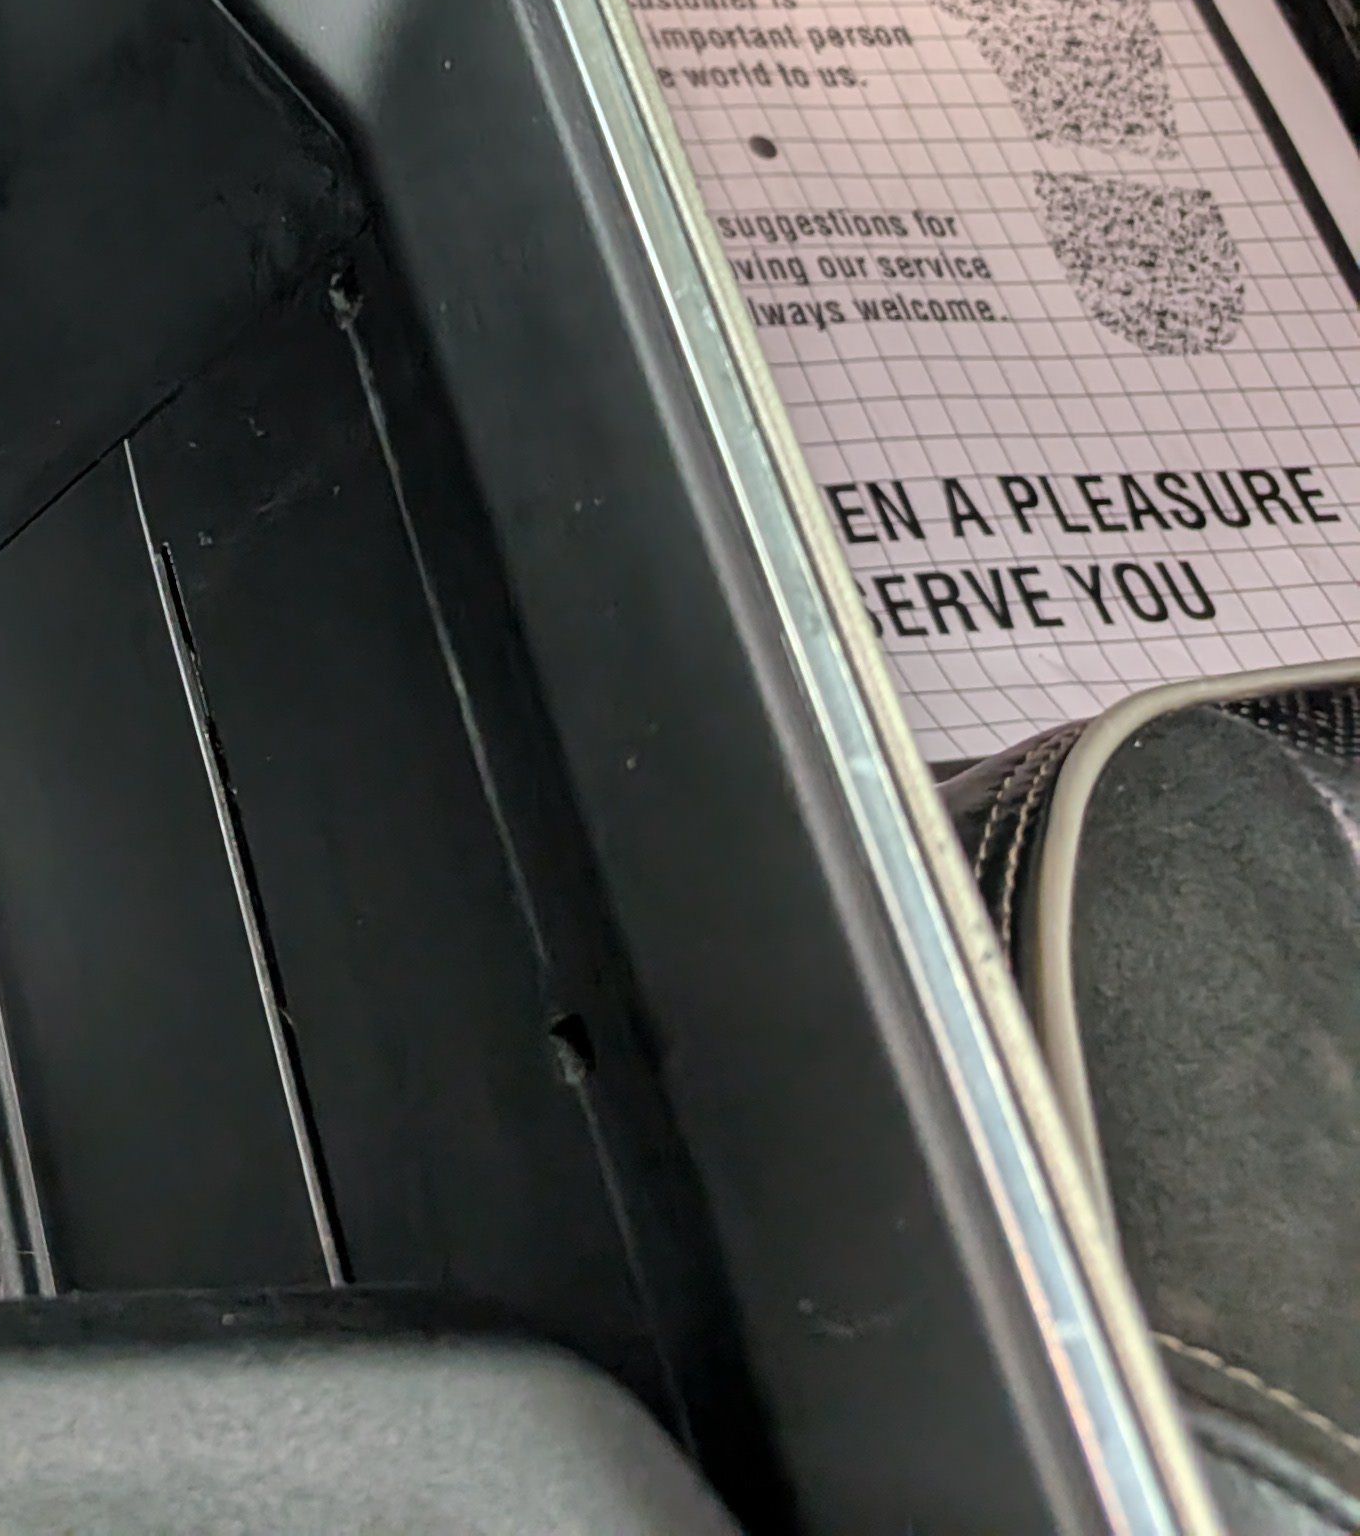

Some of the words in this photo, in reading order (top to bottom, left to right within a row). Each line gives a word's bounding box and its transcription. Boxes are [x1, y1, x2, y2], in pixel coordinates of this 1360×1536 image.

[646, 23, 800, 55] important
[806, 25, 914, 55] person
[682, 60, 772, 88] world
[776, 62, 811, 88] to
[816, 65, 868, 88] us.
[717, 209, 908, 242] suggestions
[912, 210, 958, 237] for
[817, 255, 868, 279] our
[879, 250, 992, 279] service
[853, 293, 1008, 323] welcome.
[942, 477, 994, 539] A
[1000, 467, 1341, 534] PLEASURE
[1060, 561, 1216, 626] YOU
